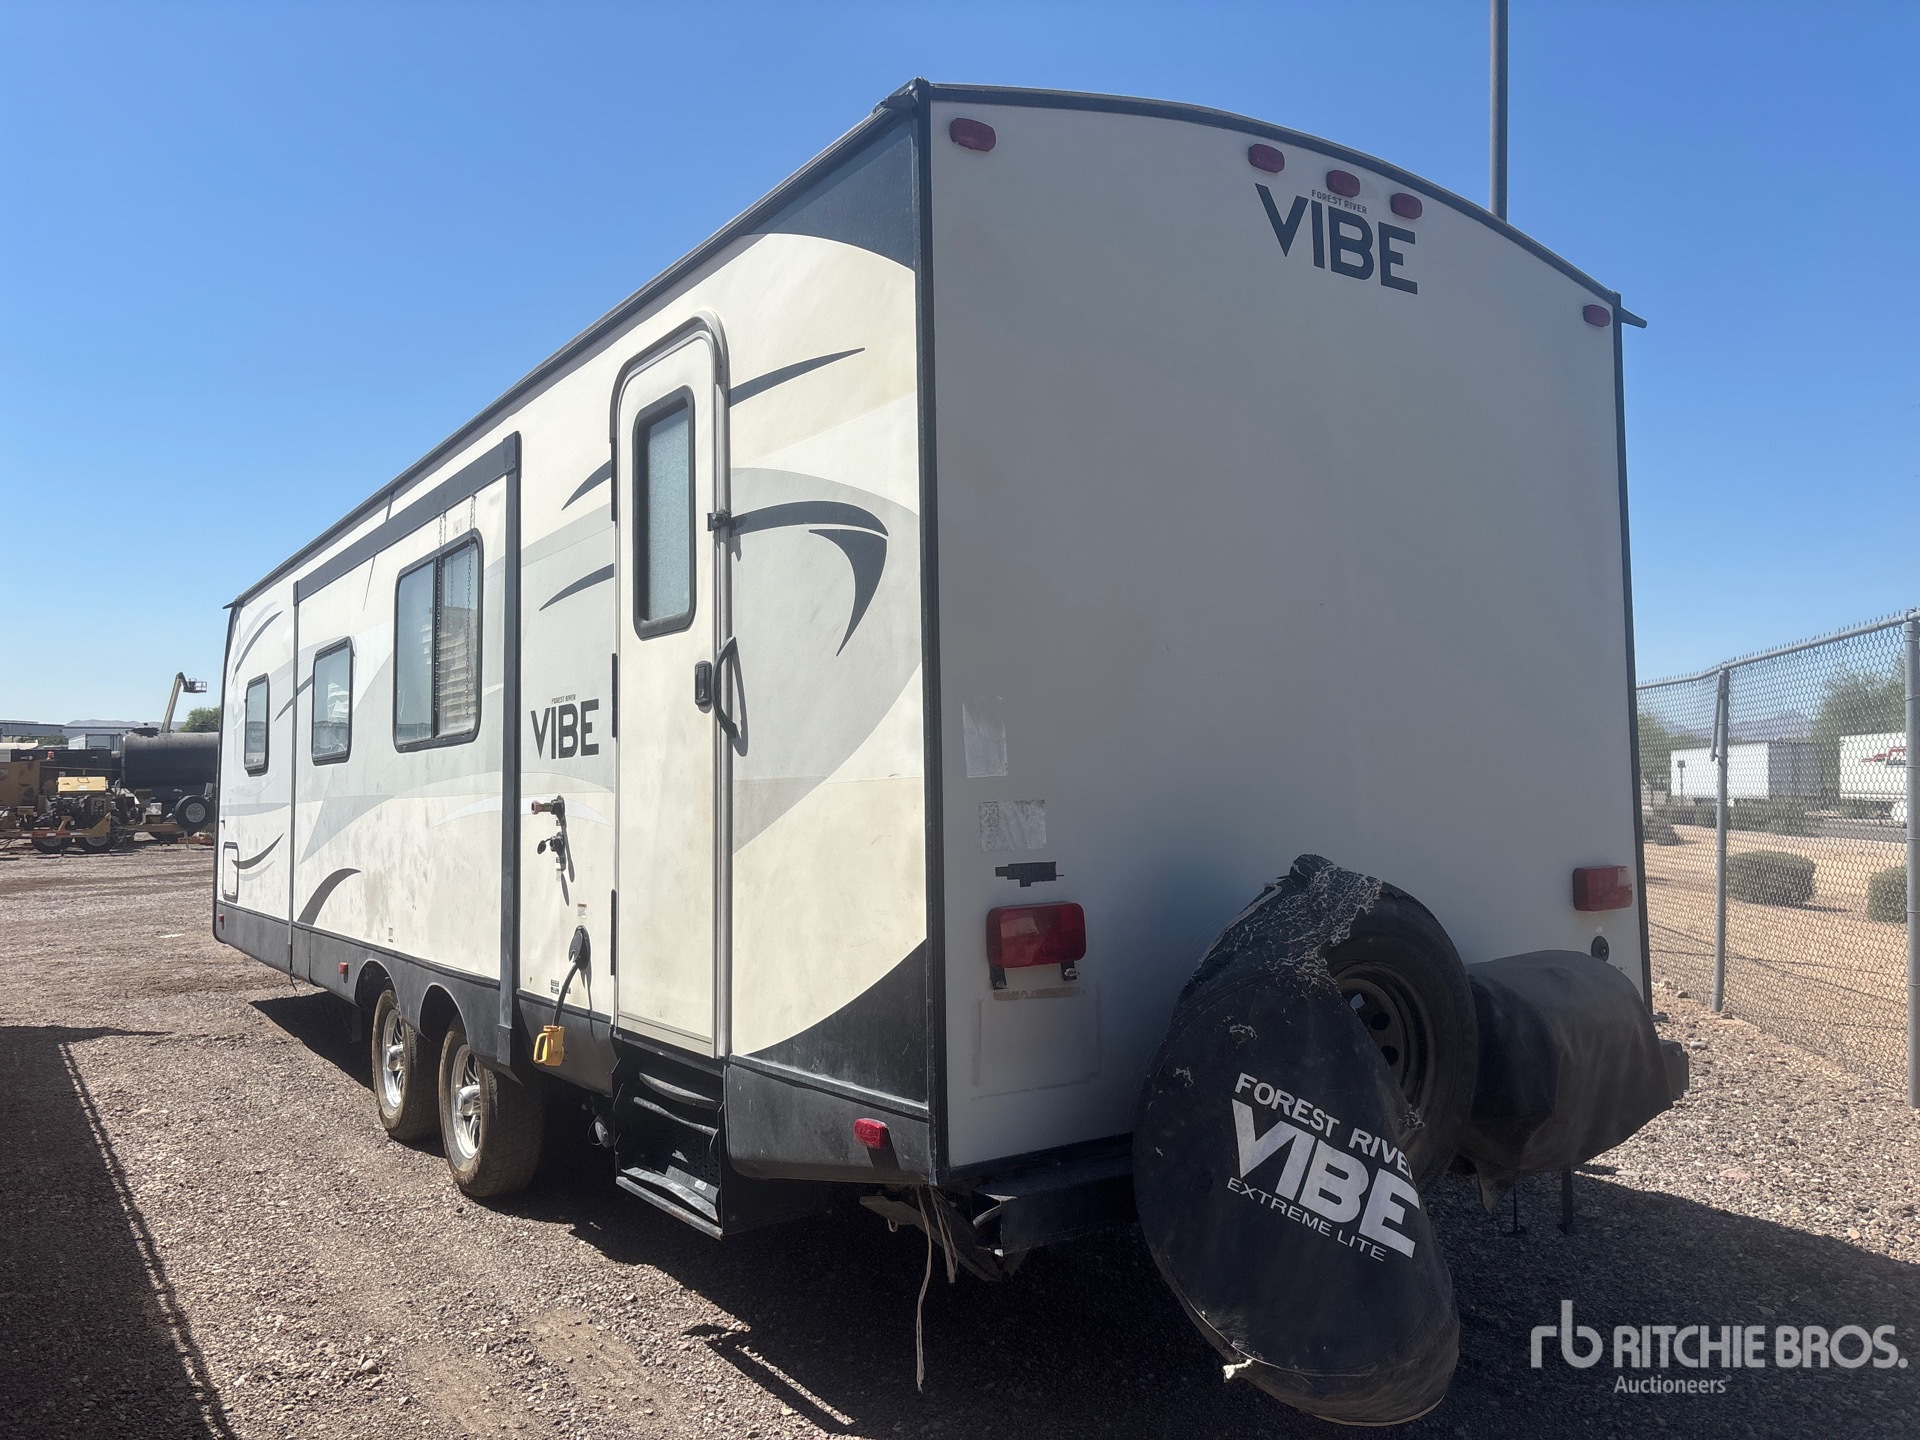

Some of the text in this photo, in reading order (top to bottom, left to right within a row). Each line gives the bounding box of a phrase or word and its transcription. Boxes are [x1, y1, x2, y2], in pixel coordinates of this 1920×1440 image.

[1255, 183, 1418, 295] VIBE
[1311, 189, 1368, 215] FOREST RIVER
[530, 698, 599, 760] VIBE
[1234, 1072, 1341, 1138] FOREST
[1231, 1098, 1420, 1259] VIBE
[1226, 1176, 1387, 1262] EXTREME LITE
